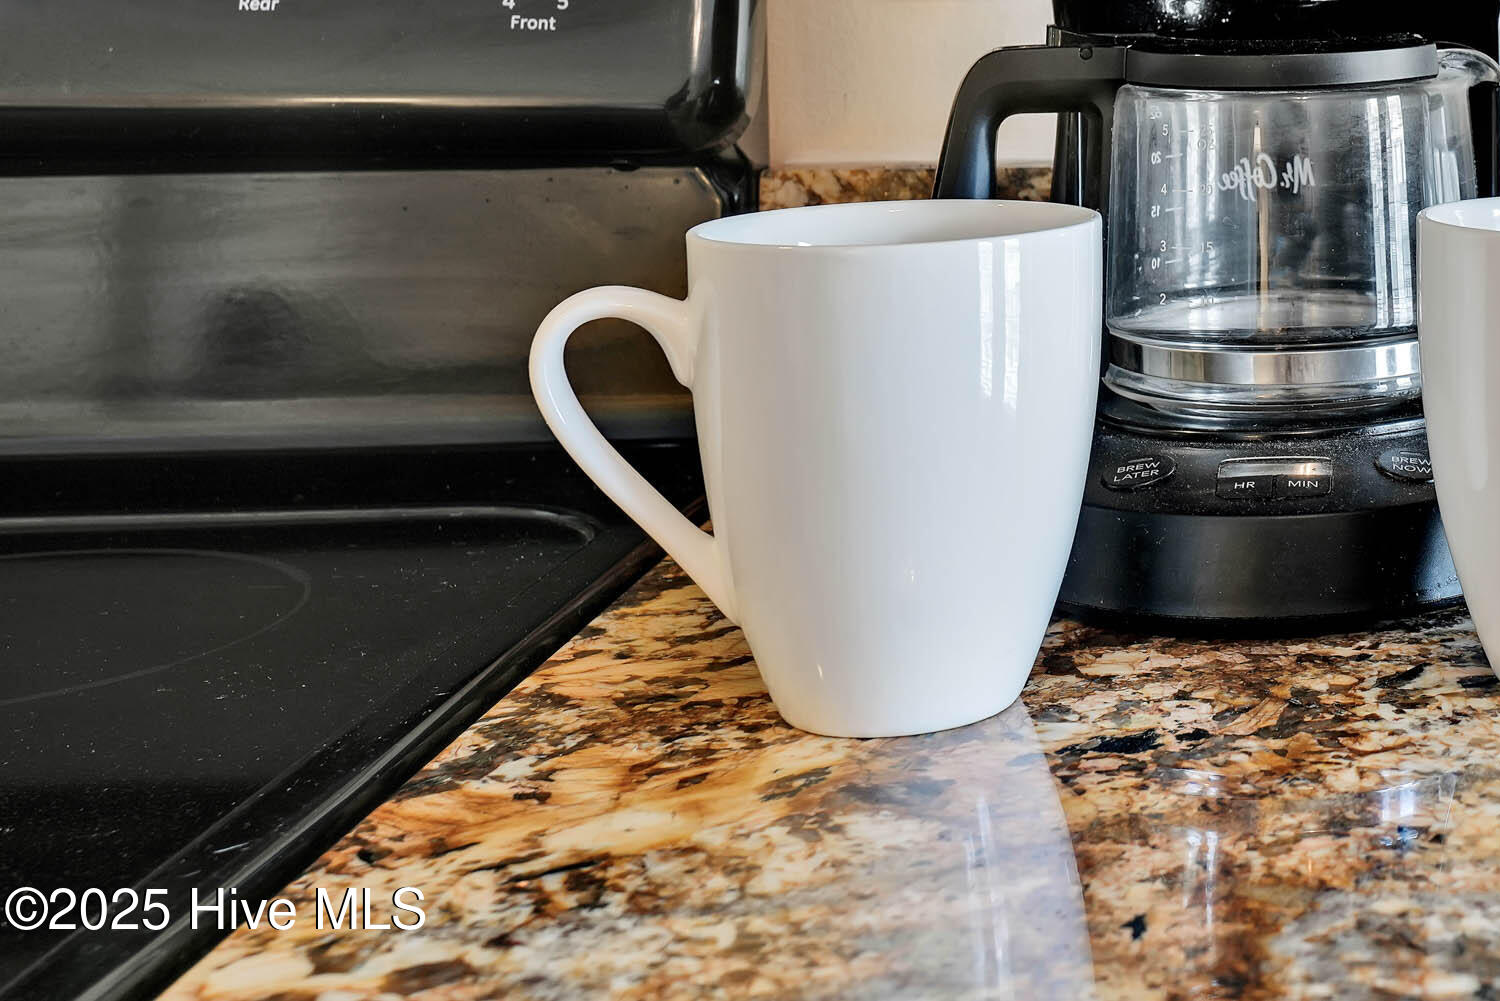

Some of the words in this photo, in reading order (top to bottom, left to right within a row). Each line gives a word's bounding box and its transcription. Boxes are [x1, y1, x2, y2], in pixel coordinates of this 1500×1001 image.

[510, 14, 557, 31] Front
[1162, 124, 1169, 136] 5
[1160, 183, 1168, 196] 4
[1160, 240, 1167, 252] 3
[1160, 293, 1167, 305] 2
[1391, 456, 1432, 466] BREW
[1117, 461, 1161, 474] BREW
[1392, 463, 1432, 474] NOW
[1113, 469, 1160, 482] LATER
[1234, 481, 1256, 490] HR
[1287, 480, 1319, 489] MIN
